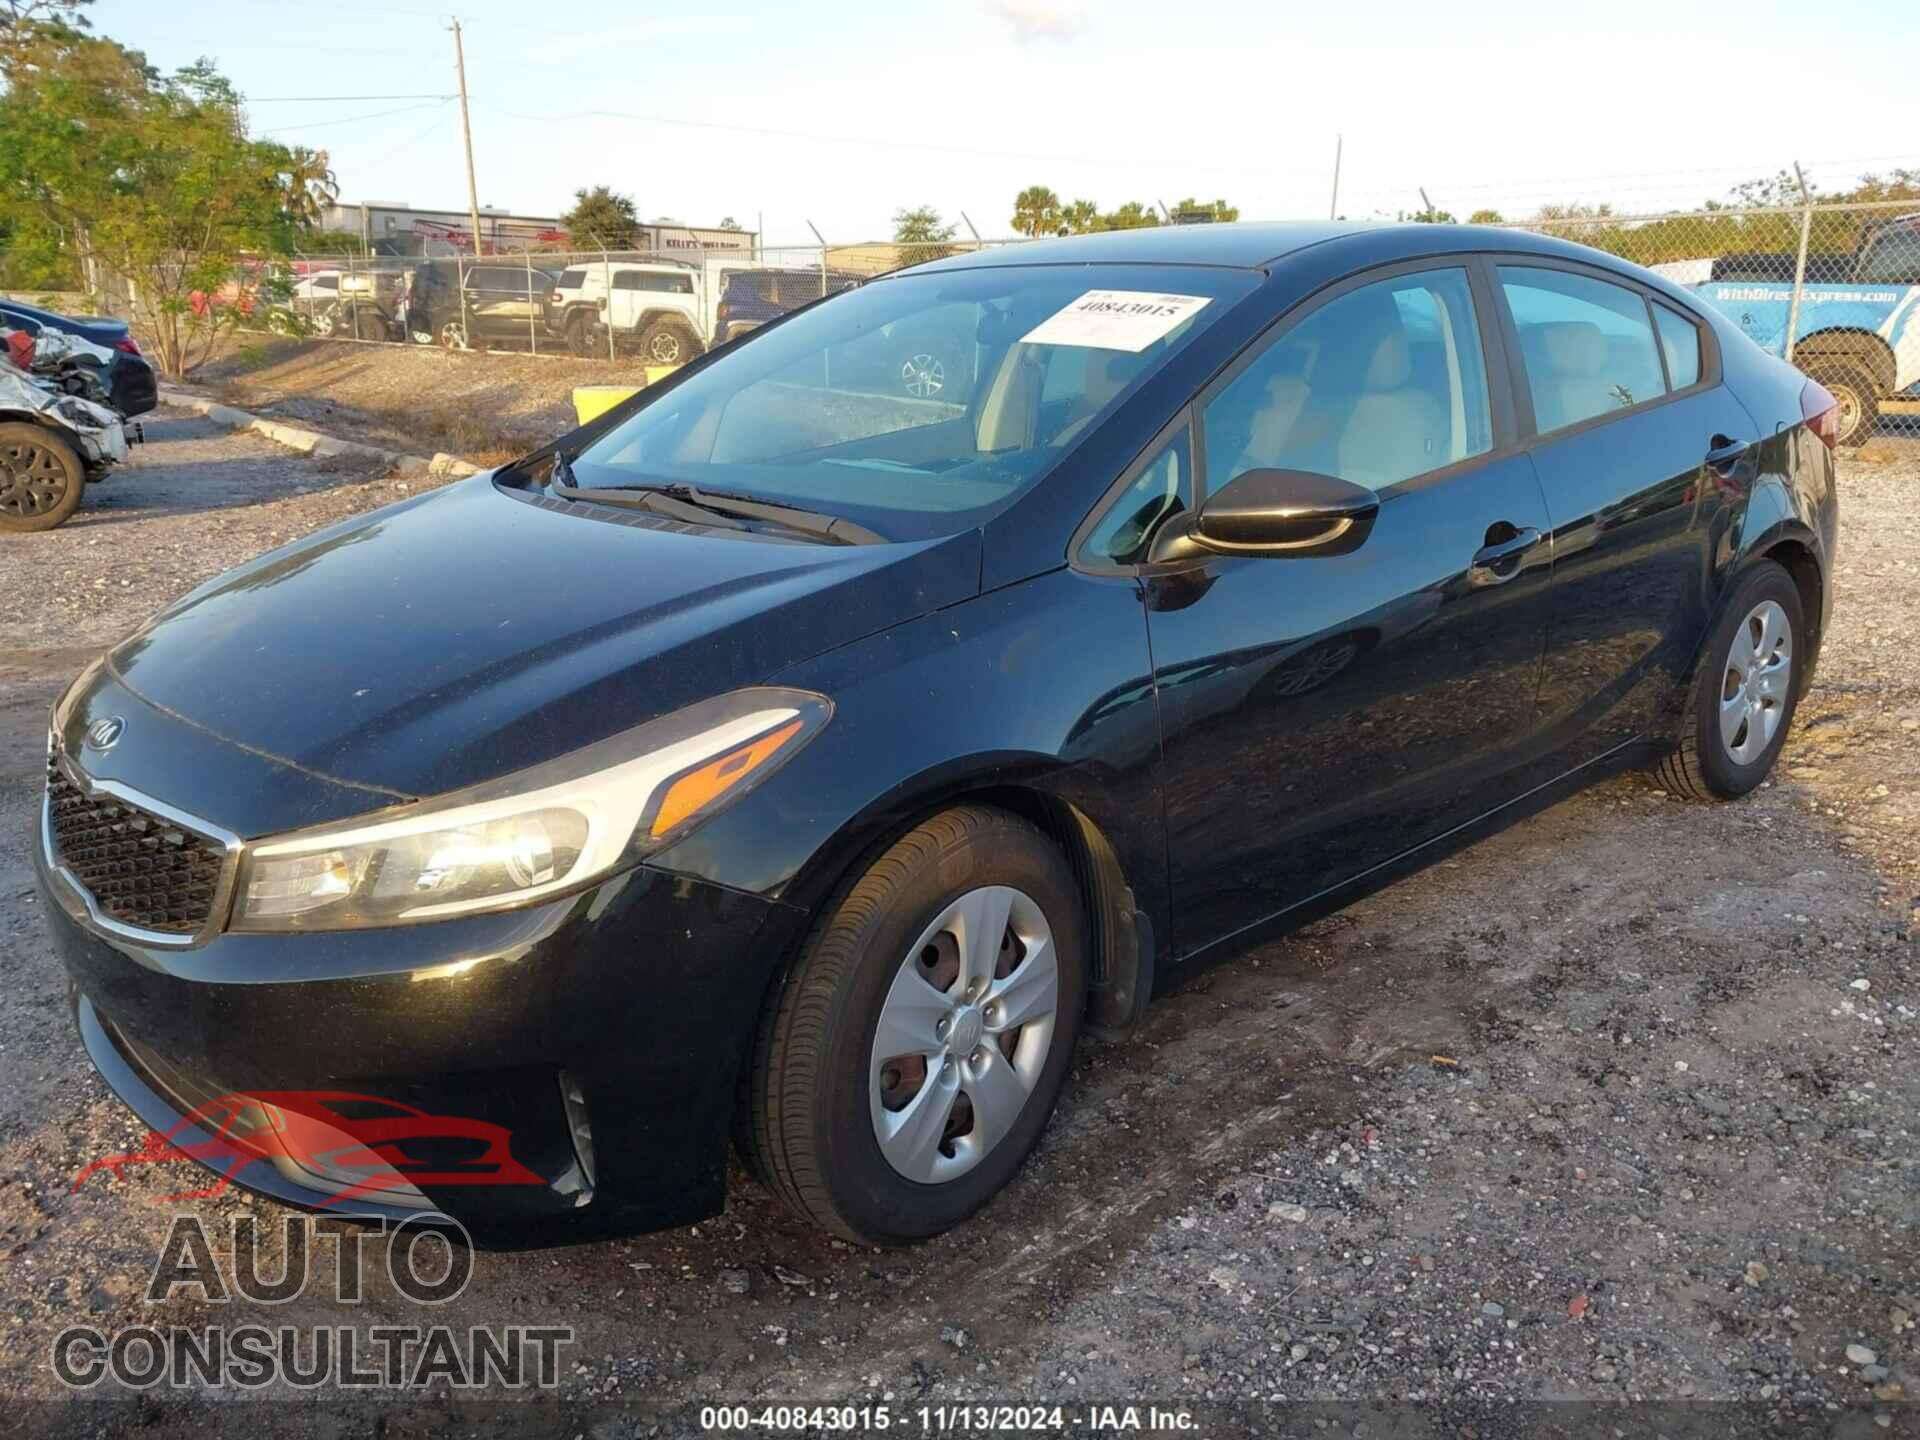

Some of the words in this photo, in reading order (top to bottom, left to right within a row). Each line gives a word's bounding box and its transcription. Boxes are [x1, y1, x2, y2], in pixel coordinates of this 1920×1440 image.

[666, 239, 697, 249] KELLY'S
[1717, 286, 1897, 304] WithDirecExpress.com
[1077, 301, 1181, 317] 40843015
